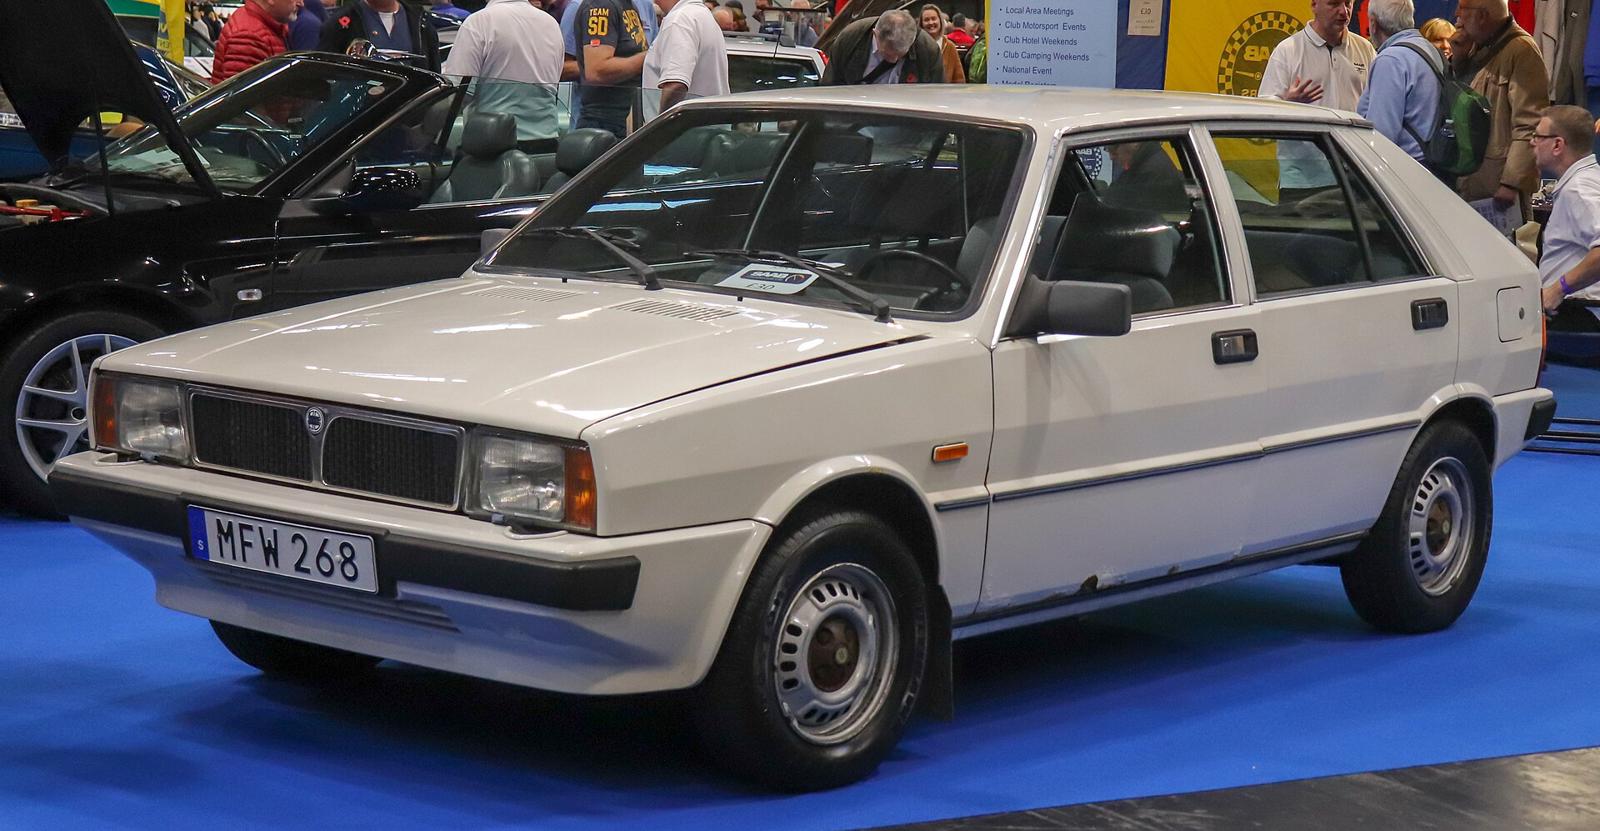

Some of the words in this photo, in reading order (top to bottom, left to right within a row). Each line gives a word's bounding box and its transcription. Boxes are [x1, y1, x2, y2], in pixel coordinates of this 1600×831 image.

[589, 8, 609, 17] TEAM
[1026, 7, 1041, 15] Area
[1044, 8, 1074, 17] Meetings
[588, 16, 608, 36] SD
[1022, 22, 1059, 31] Motorsport
[1063, 23, 1086, 31] Events
[1004, 36, 1020, 44] Club
[1022, 37, 1040, 45] Hotel
[1041, 37, 1077, 46] Weekends
[1003, 51, 1019, 59] Club
[1021, 51, 1051, 61] Camping
[1053, 53, 1089, 61] Weekends
[1002, 65, 1031, 74] National
[1032, 66, 1052, 75] Event
[197, 540, 204, 550] S
[216, 518, 279, 568] MFW
[291, 533, 359, 582] 268
